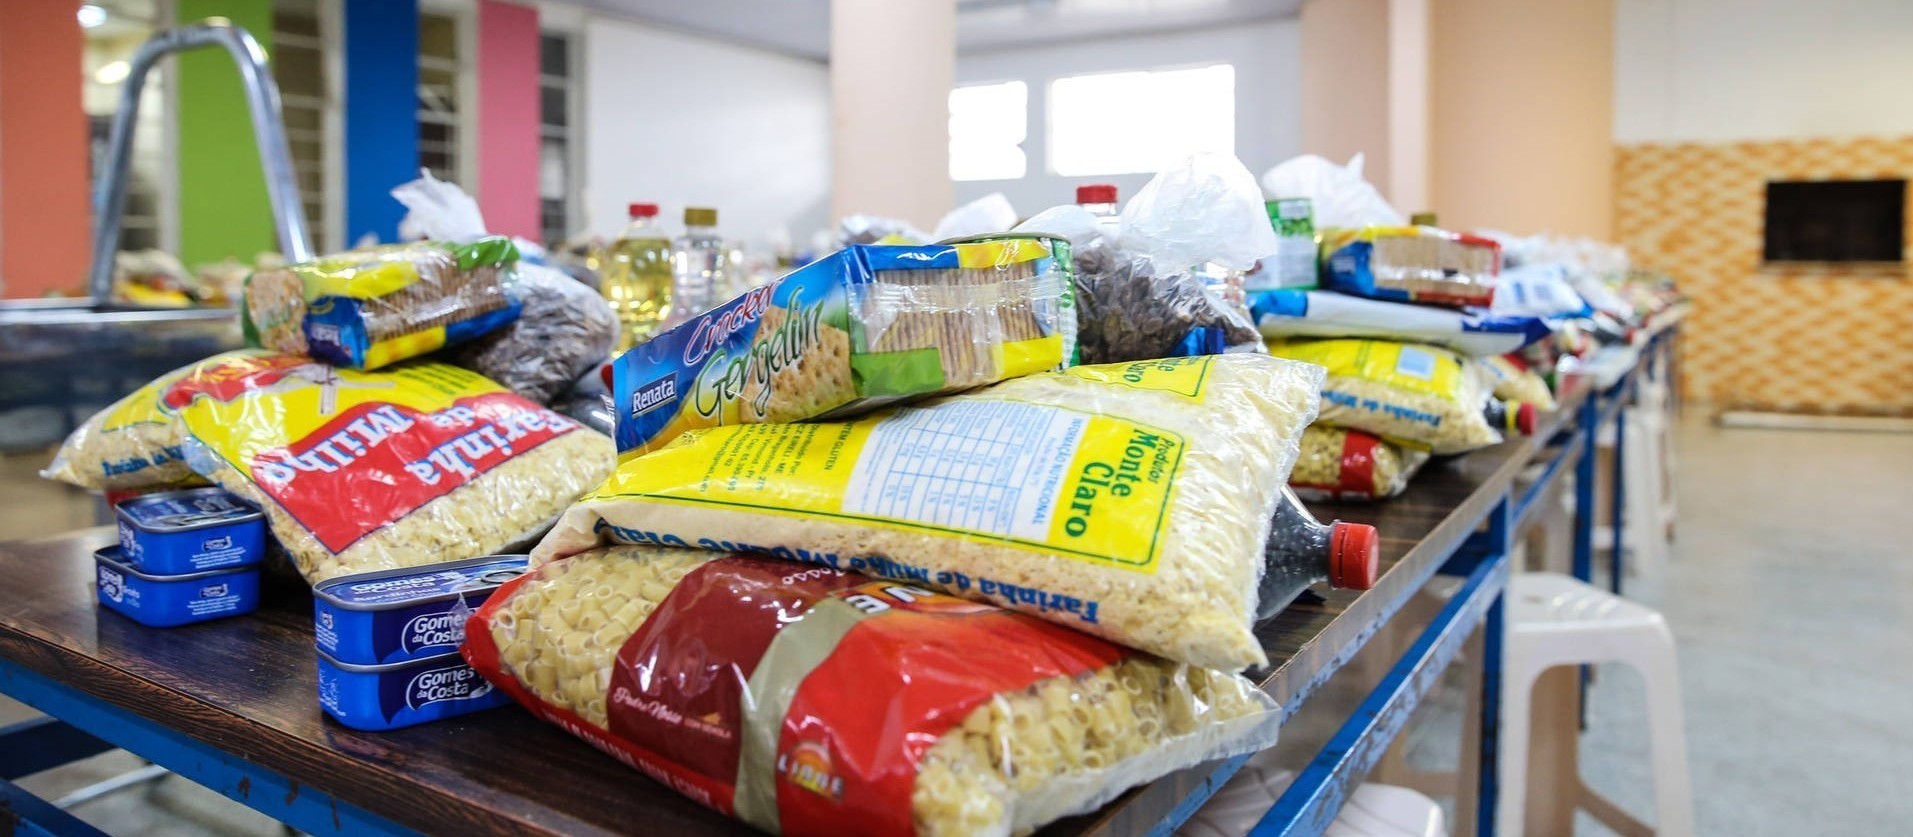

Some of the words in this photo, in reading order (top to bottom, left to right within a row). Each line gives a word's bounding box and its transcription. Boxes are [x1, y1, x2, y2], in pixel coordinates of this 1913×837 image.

[683, 277, 785, 367] Cracker
[696, 285, 824, 426] Gergelim
[432, 405, 475, 428] de
[632, 379, 675, 414] Renata
[262, 405, 414, 484] Milho
[404, 408, 577, 486] Farinha
[1111, 429, 1160, 497] Monte
[1064, 462, 1114, 537] Claro
[936, 571, 971, 591] de
[979, 577, 1099, 624] Farinha
[412, 634, 423, 643] da
[423, 629, 465, 645] Costa
[414, 614, 462, 633] Gome
[416, 689, 428, 698] da
[428, 682, 470, 700] Costa
[418, 667, 475, 689] Gomes
